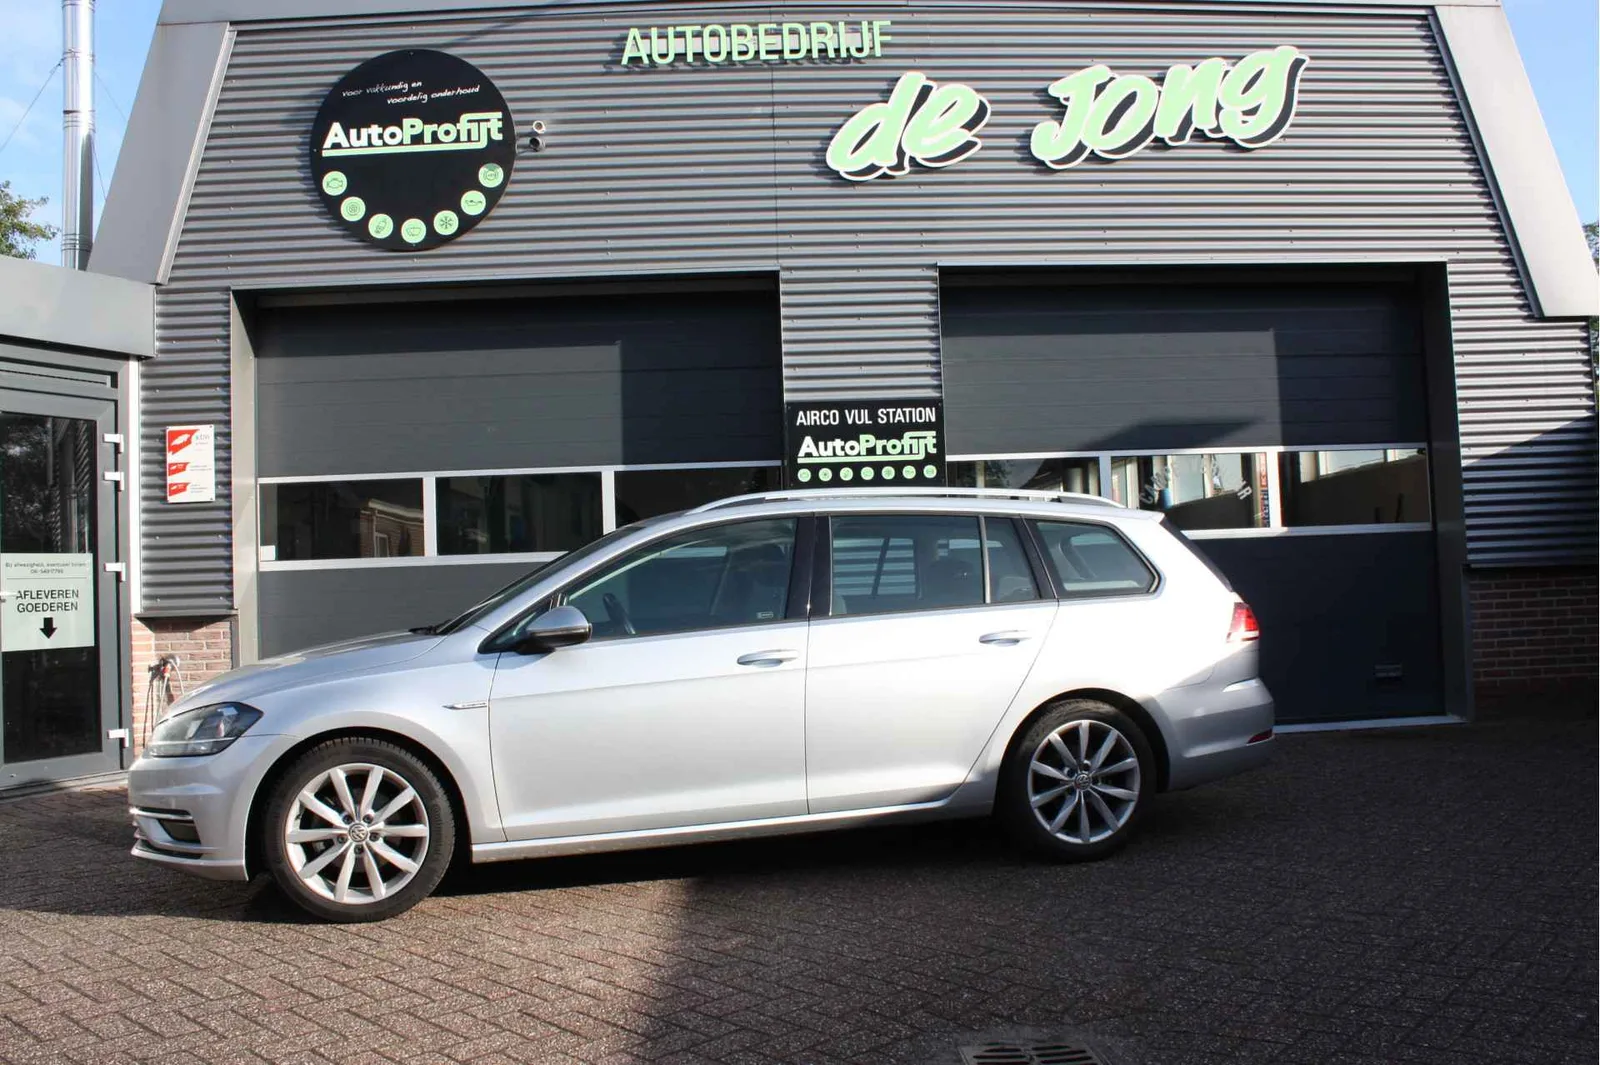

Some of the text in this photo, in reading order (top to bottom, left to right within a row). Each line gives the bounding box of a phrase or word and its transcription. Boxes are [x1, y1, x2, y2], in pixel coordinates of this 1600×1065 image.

[621, 20, 892, 66] AUTOBEDRIJF
[342, 89, 362, 97] voor
[366, 81, 409, 94] vakkundig
[387, 85, 480, 105] voordelig onderhoud
[826, 45, 1310, 182] de Jong
[796, 407, 936, 426] AIRCO VUL STATION
[15, 589, 79, 600] AFLEVEREN
[17, 602, 78, 613] GOEDEREN
